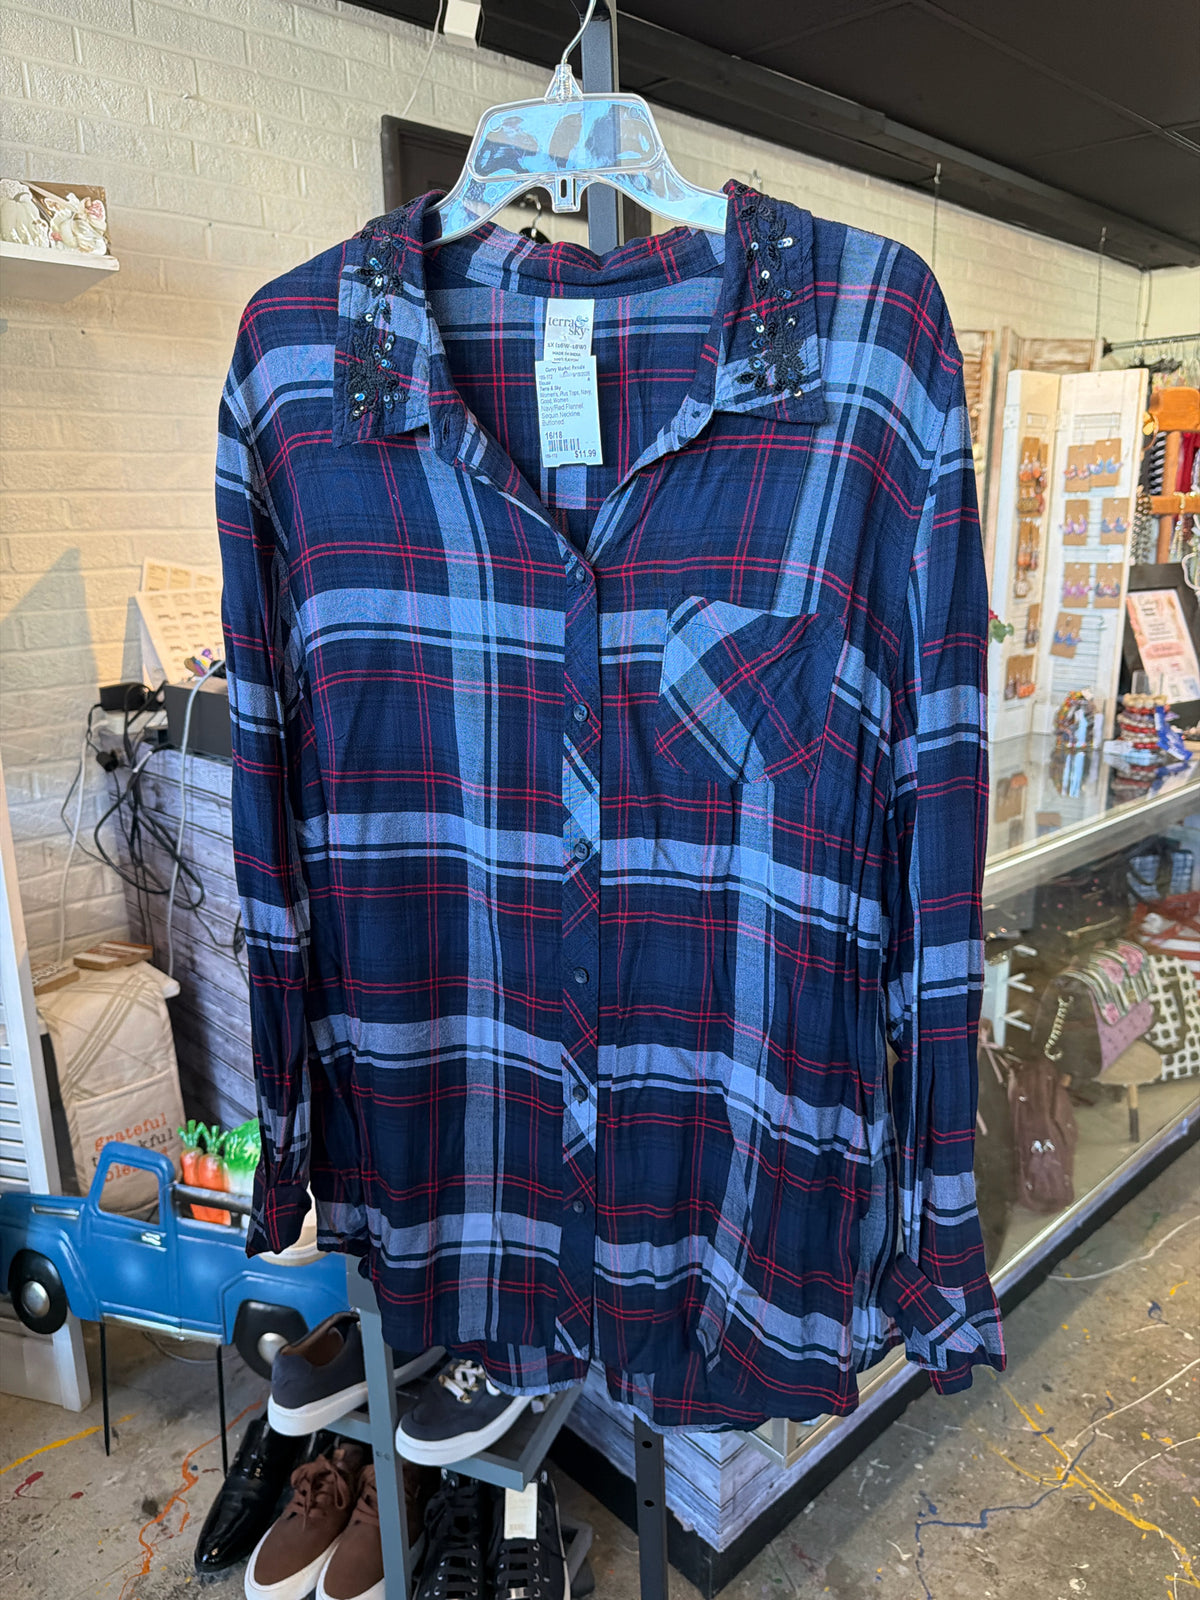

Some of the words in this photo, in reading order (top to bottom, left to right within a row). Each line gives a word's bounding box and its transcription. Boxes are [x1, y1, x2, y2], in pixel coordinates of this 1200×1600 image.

[548, 317, 574, 327] terra
[568, 326, 585, 340] sky
[575, 449, 597, 458] $11.99
[95, 1112, 167, 1152] grateful
